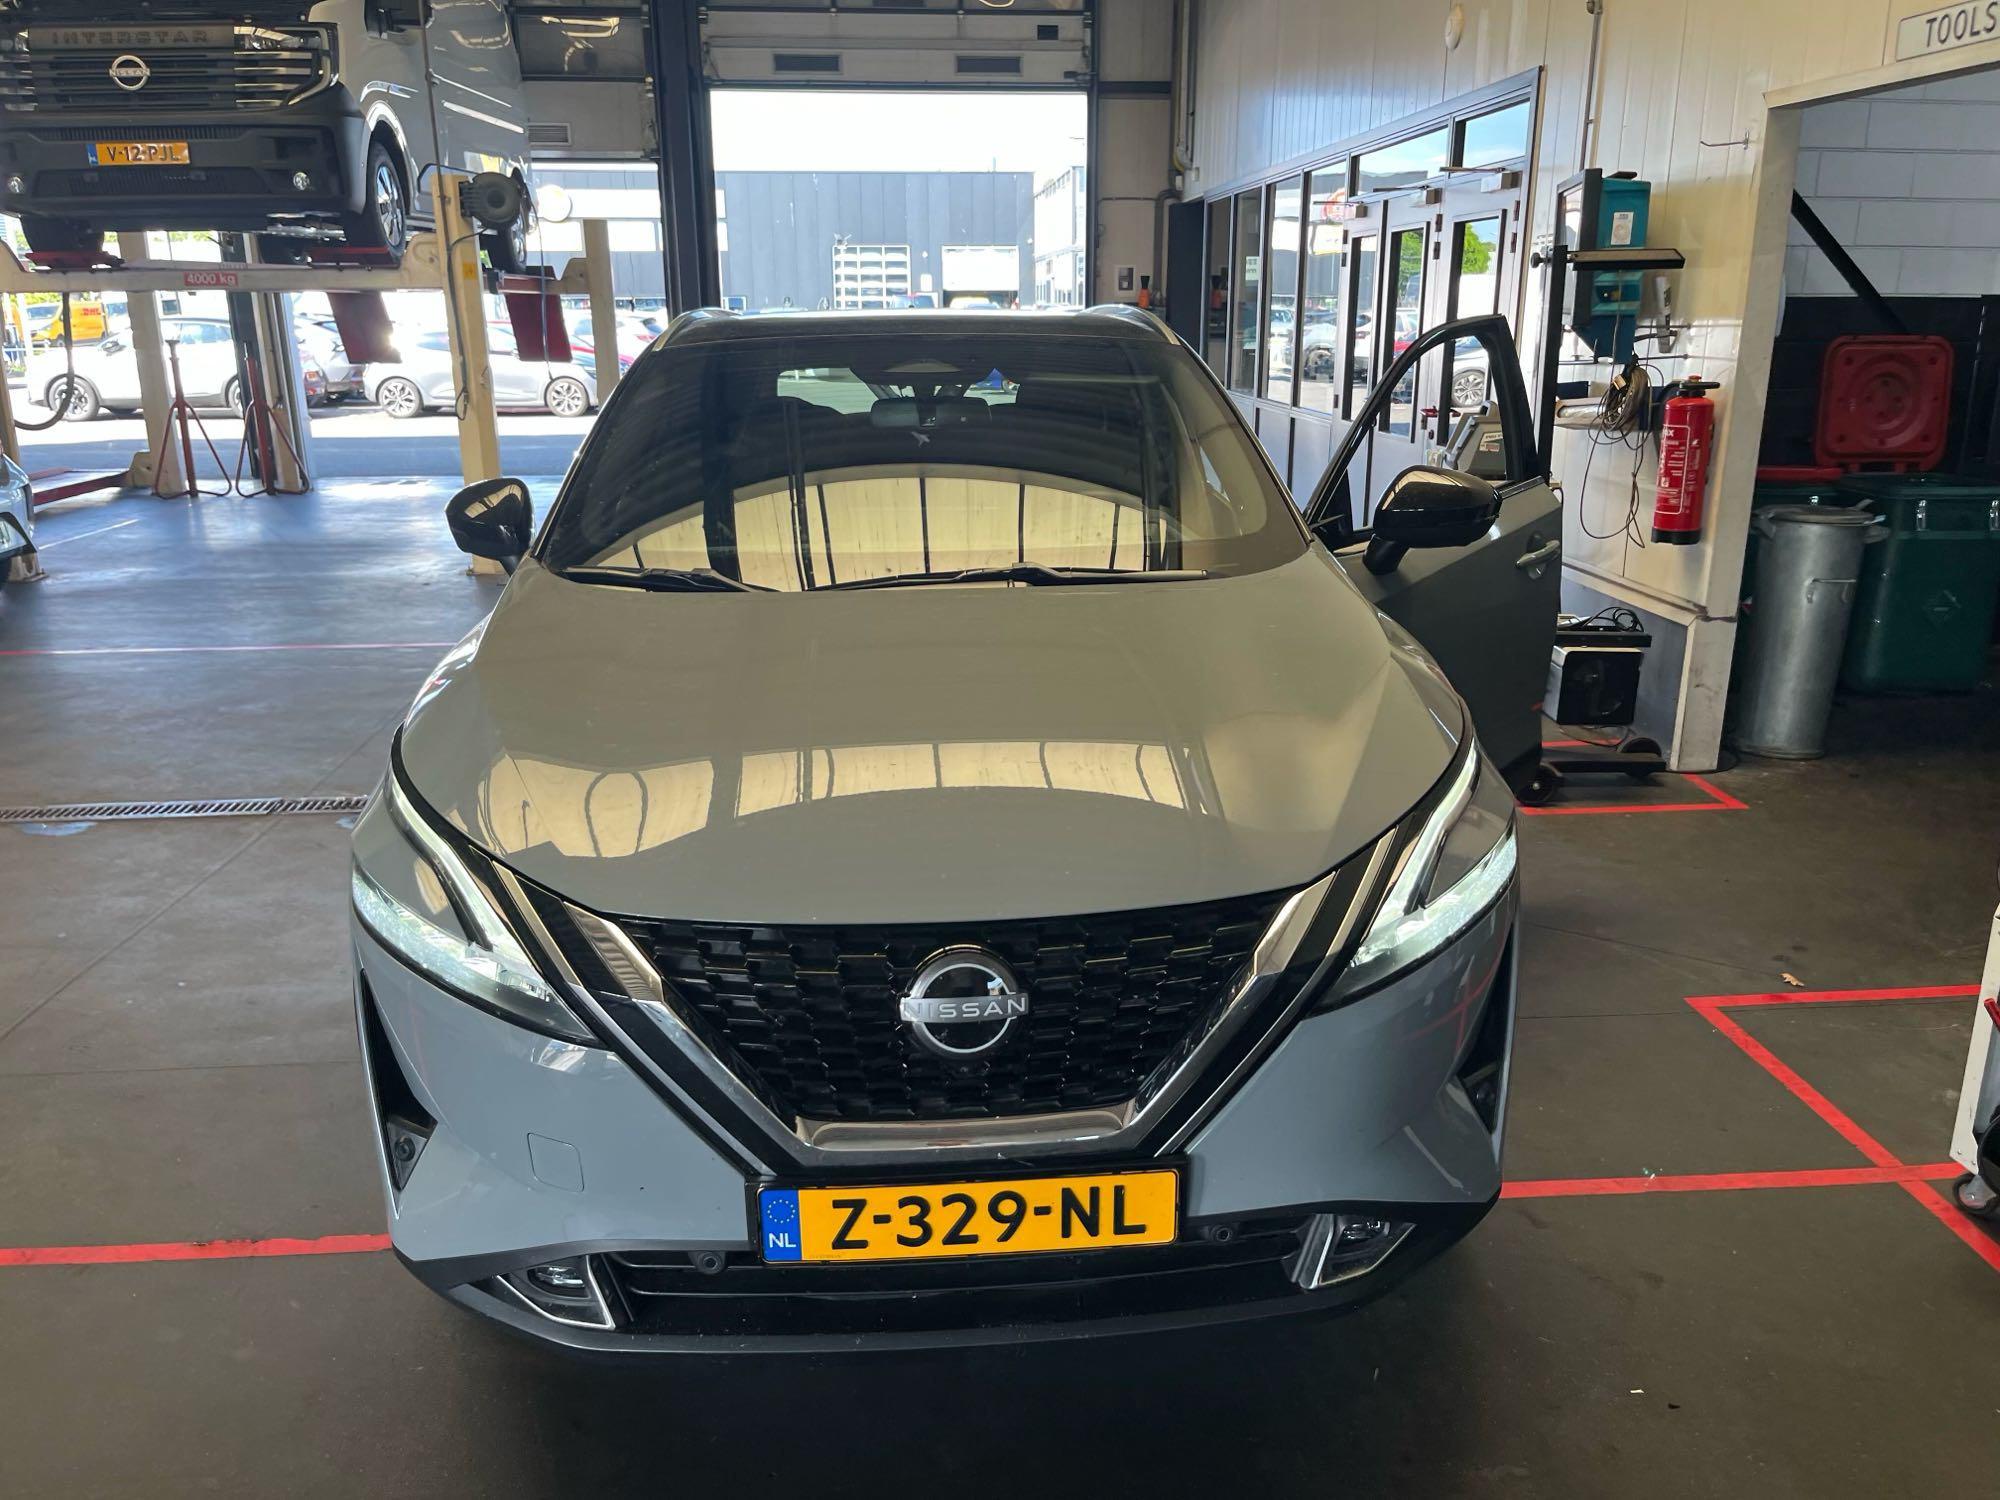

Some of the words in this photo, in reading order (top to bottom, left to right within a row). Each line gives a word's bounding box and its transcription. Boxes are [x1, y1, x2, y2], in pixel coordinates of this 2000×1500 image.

[1925, 1, 1998, 48] TOOLS
[52, 29, 209, 45] INTERSTAR
[109, 68, 150, 77] NISSAN
[187, 272, 217, 285] 4000
[219, 271, 237, 287] kg
[902, 997, 1026, 1020] NISSAN
[831, 1184, 1147, 1250] Z-329-NL
[768, 1232, 797, 1249] NL
